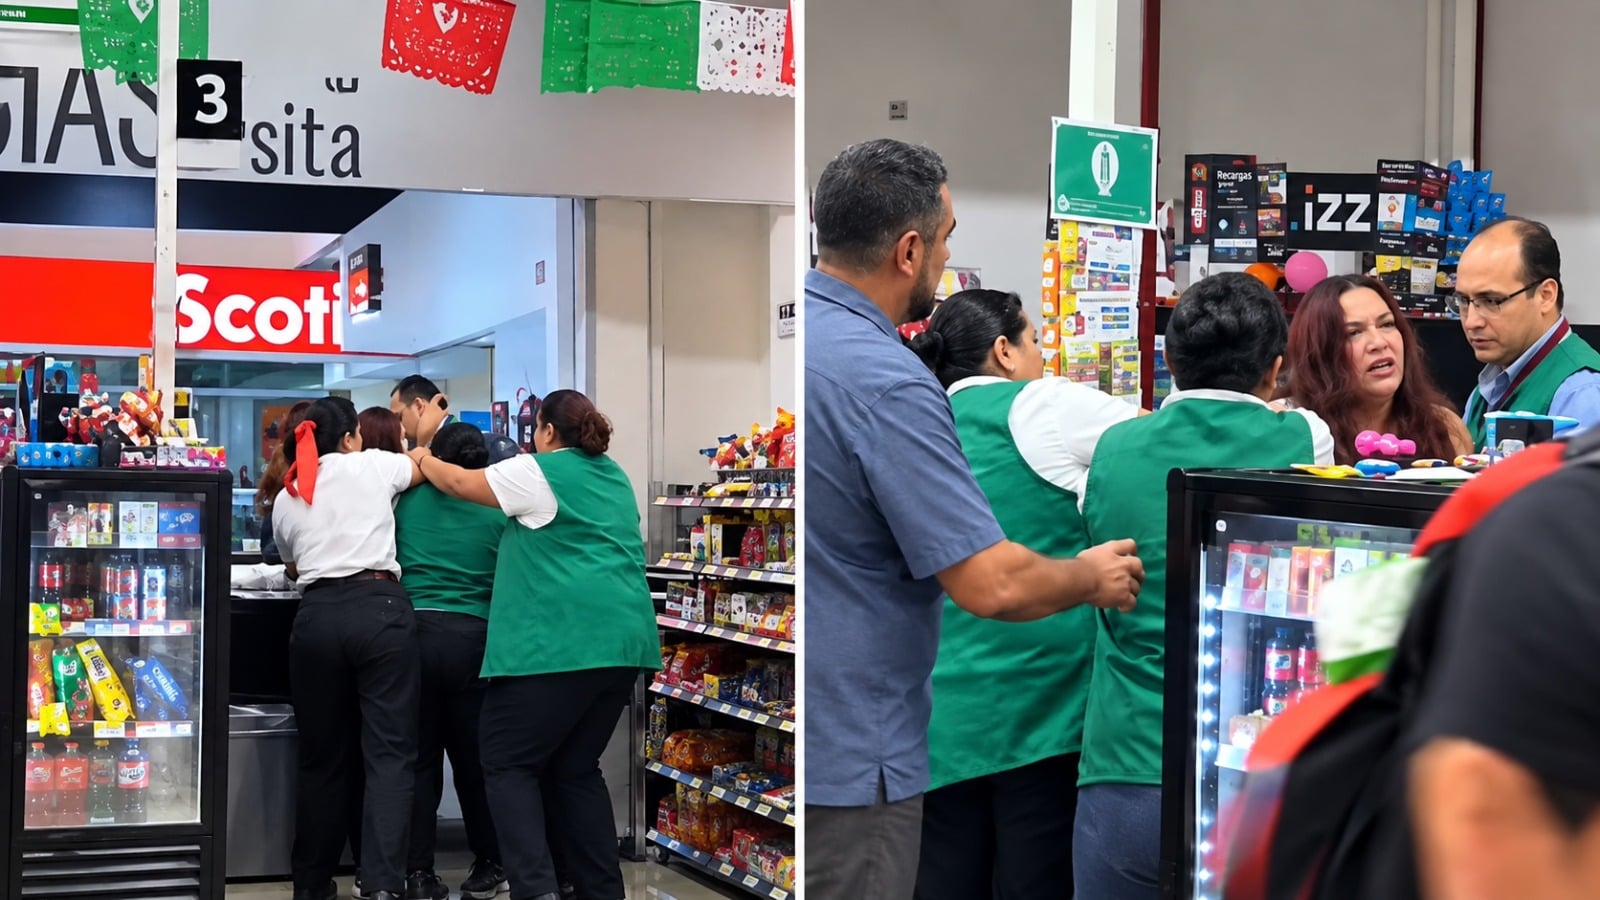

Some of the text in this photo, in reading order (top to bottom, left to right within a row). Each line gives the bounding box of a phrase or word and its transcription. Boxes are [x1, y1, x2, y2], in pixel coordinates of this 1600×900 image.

[194, 74, 228, 124] 3
[243, 102, 362, 178] sita
[1216, 170, 1253, 182] Recargas
[176, 273, 341, 345] Scoti
